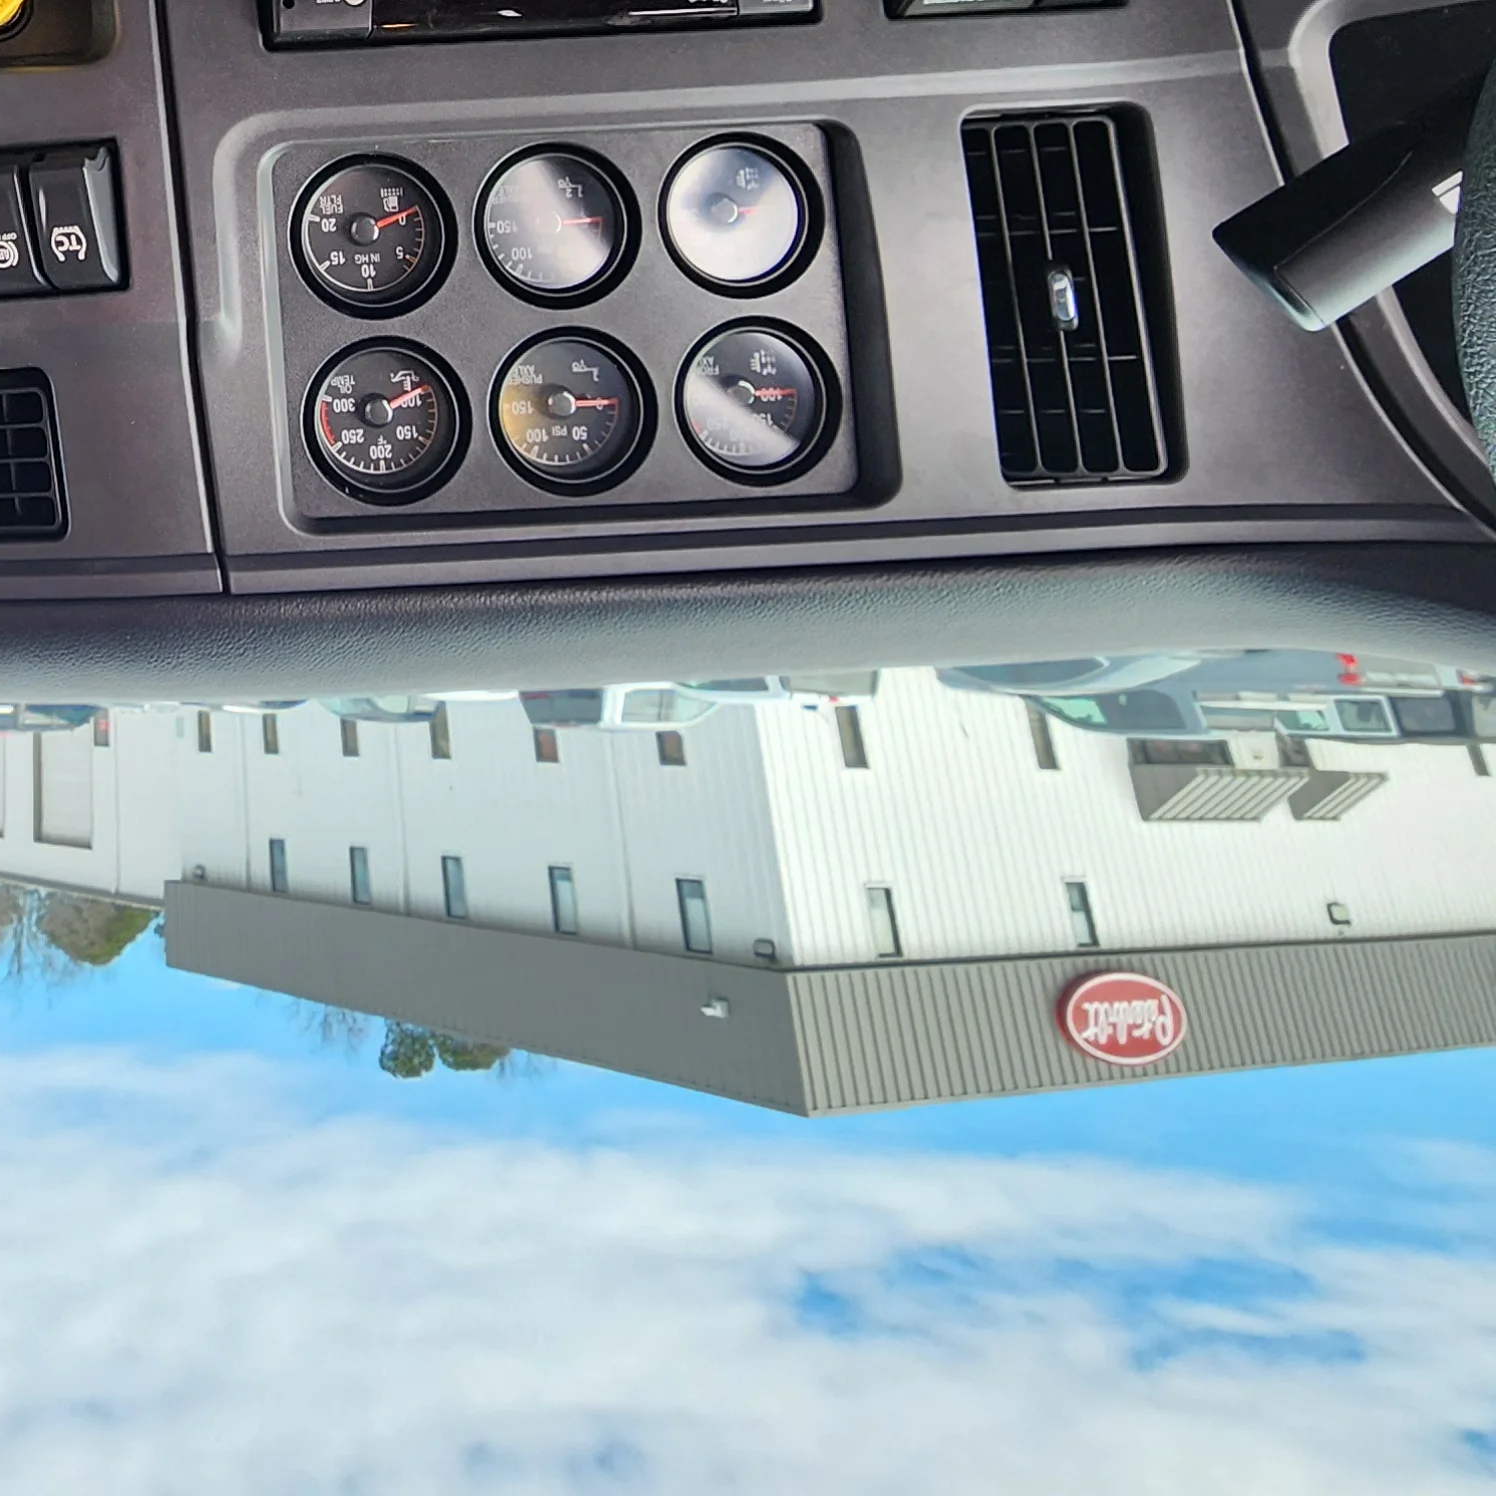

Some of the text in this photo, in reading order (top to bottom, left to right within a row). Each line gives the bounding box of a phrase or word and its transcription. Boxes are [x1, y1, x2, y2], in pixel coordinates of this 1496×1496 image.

[320, 195, 342, 205] FLTR
[320, 204, 343, 214] FUEL
[322, 218, 336, 232] 20
[497, 220, 517, 233] 150
[2, 232, 16, 240] OFF
[56, 234, 80, 251] TC
[330, 251, 345, 264] 15
[354, 253, 380, 264] IN HG
[396, 246, 403, 259] 5
[512, 248, 532, 260] 100
[362, 264, 376, 278] 10
[330, 375, 355, 386] TEMP
[338, 384, 352, 394] OIL
[333, 398, 355, 412] 300
[512, 401, 534, 414] 150
[342, 428, 364, 444] 250
[396, 426, 418, 440] 150
[526, 428, 548, 442] 100
[552, 426, 567, 436] PSI
[572, 426, 588, 440] 50
[370, 444, 392, 459] 200
[1081, 994, 1174, 1046] Peterbilt
